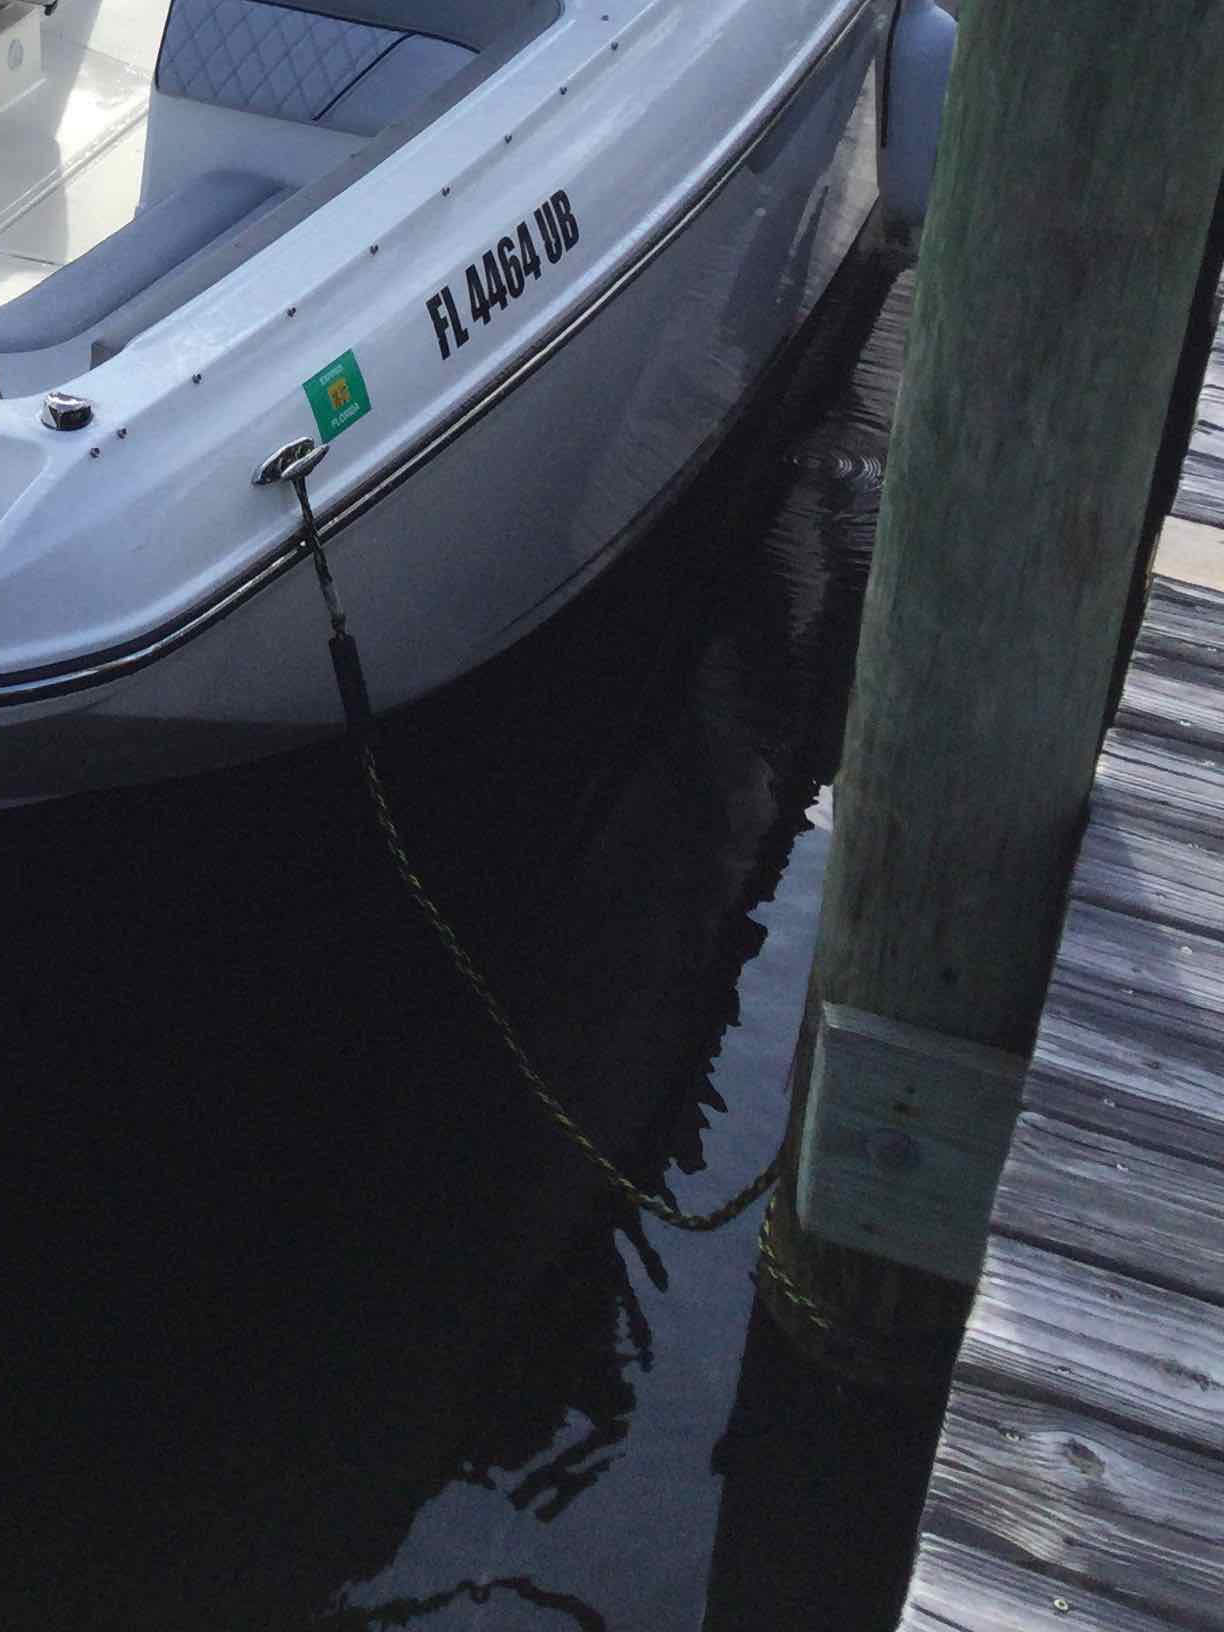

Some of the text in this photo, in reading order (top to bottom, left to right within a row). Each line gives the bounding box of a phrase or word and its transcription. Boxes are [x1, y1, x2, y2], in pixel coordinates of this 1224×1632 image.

[426, 189, 580, 361] FL 4464 UB
